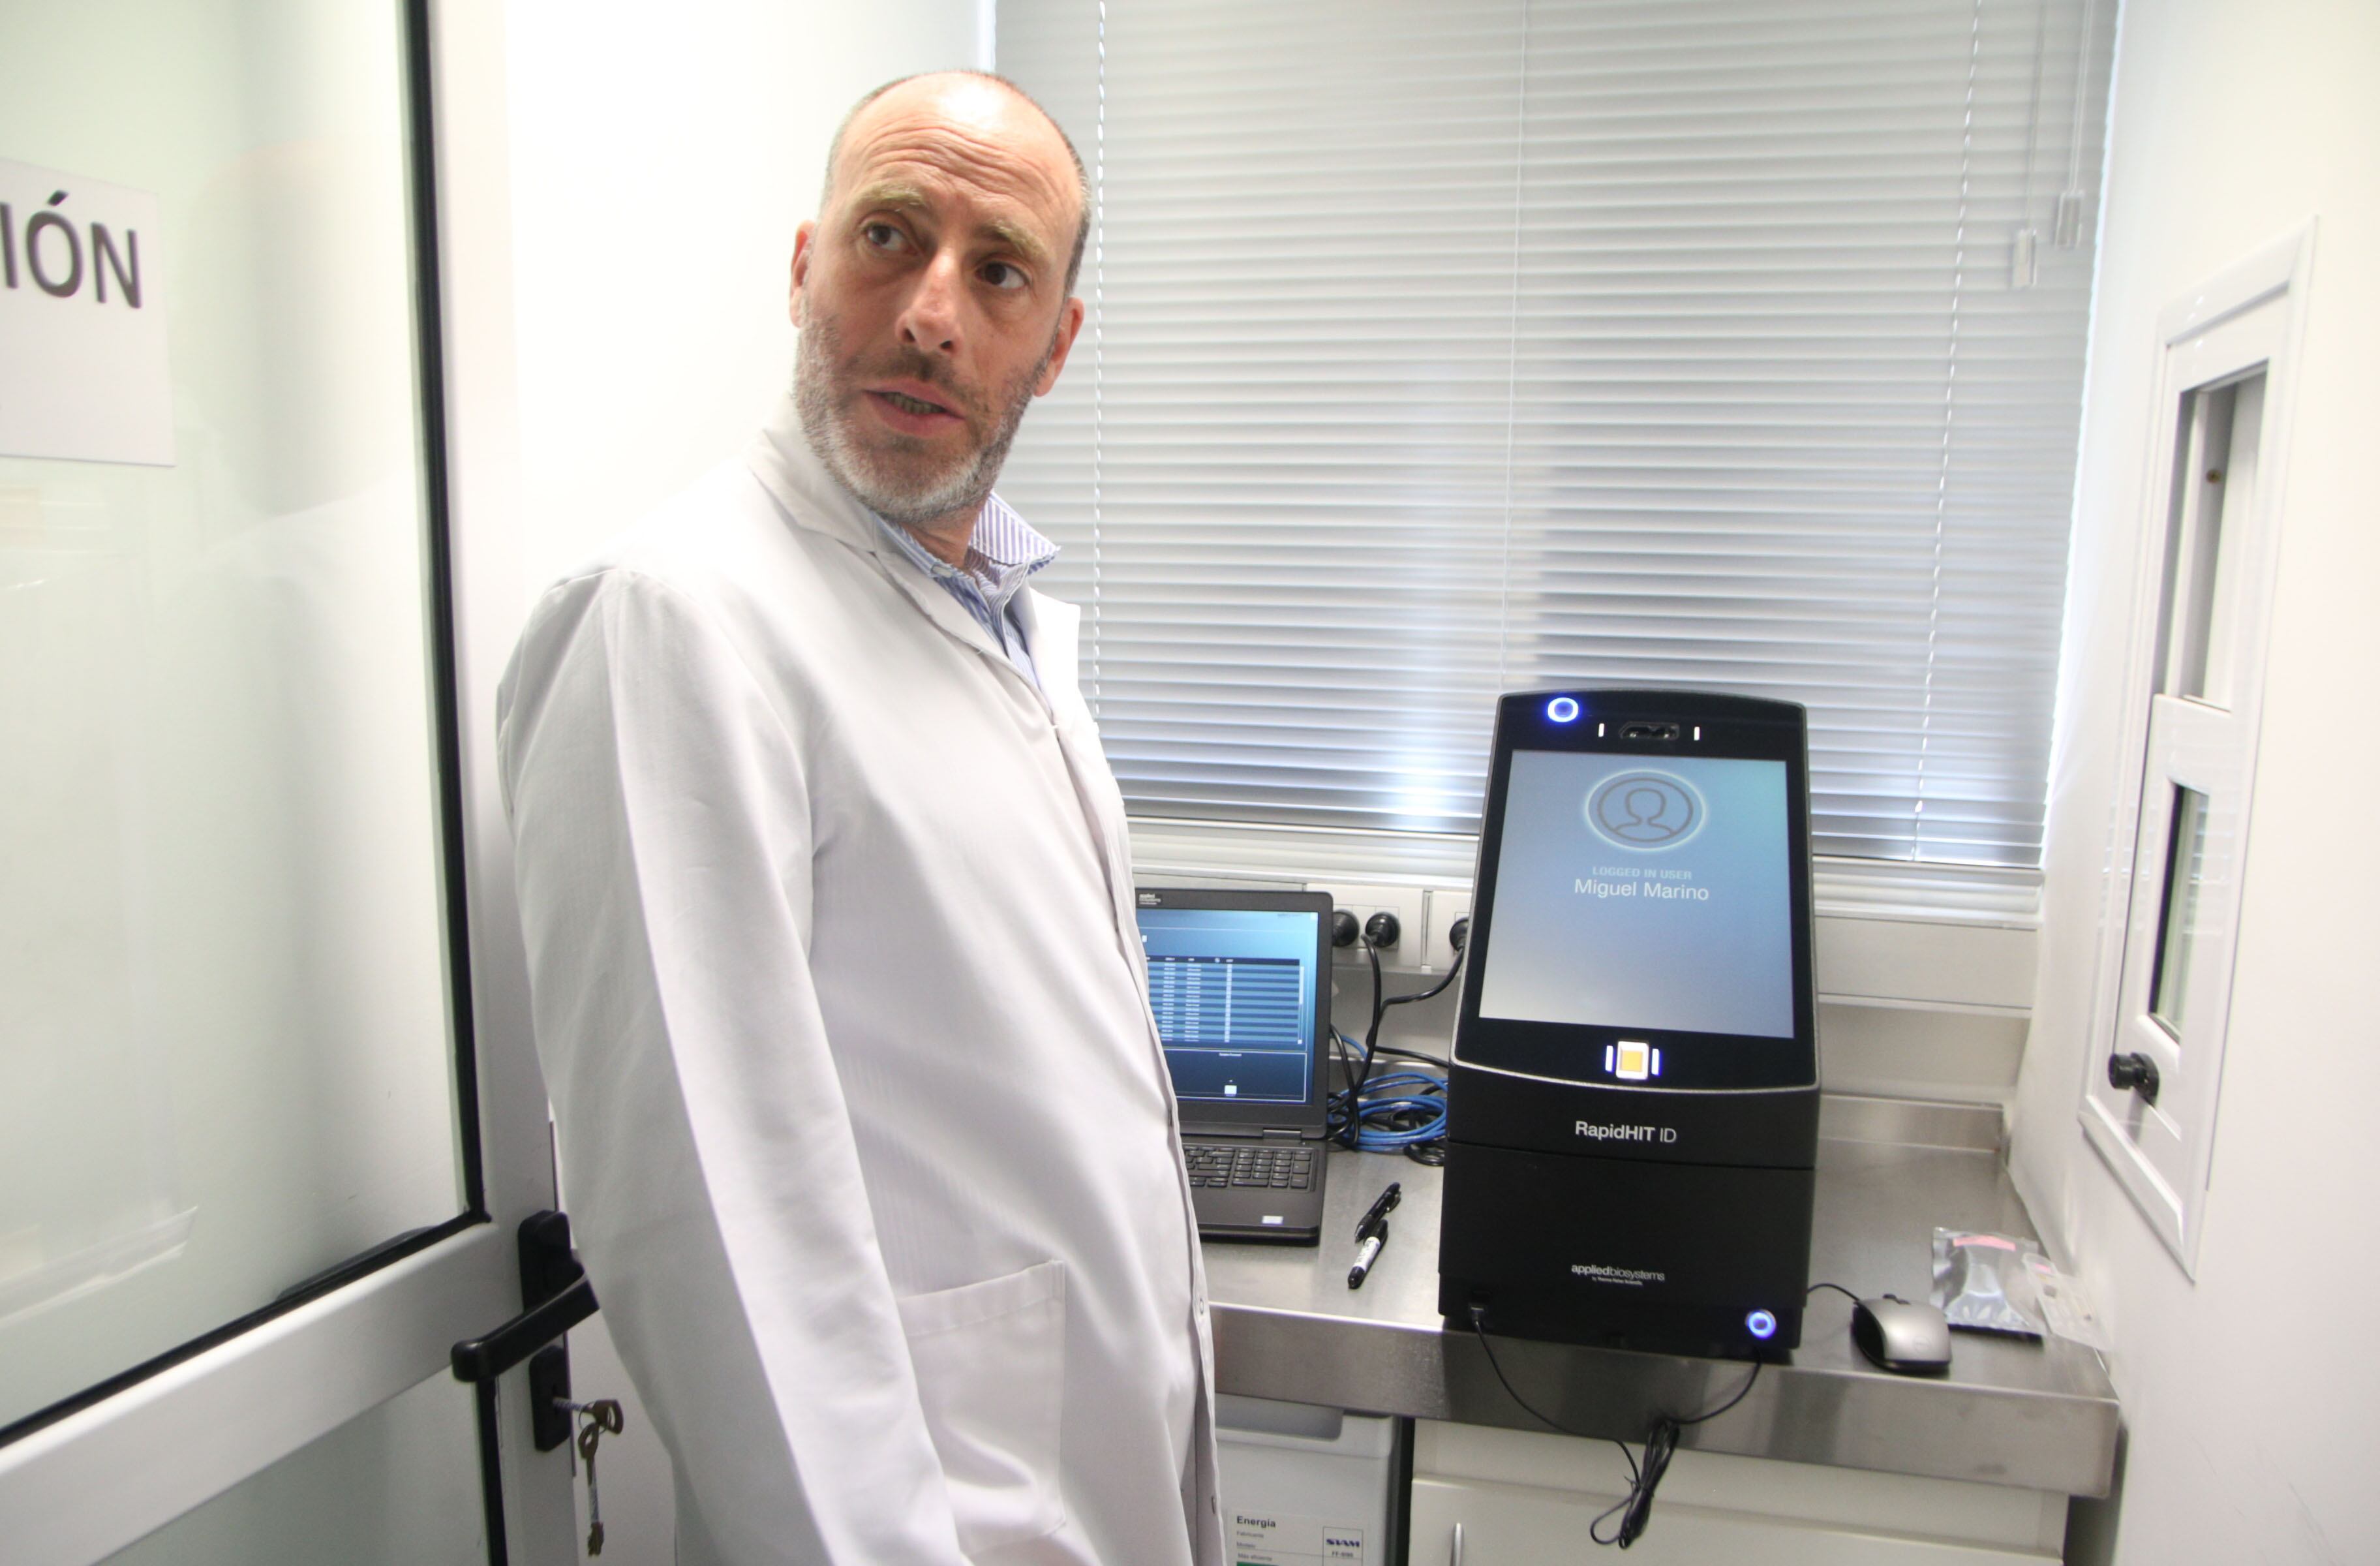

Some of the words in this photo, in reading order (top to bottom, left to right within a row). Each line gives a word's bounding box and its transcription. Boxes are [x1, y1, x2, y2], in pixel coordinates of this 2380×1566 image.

[1592, 866, 1640, 878] LOGGED
[1643, 868, 1657, 878] IN
[1660, 869, 1692, 880] USER
[1574, 878, 1637, 898] Miguel
[1643, 882, 1709, 900] Marino
[1575, 1120, 1656, 1141] RapidHIT
[1659, 1128, 1677, 1143] ID
